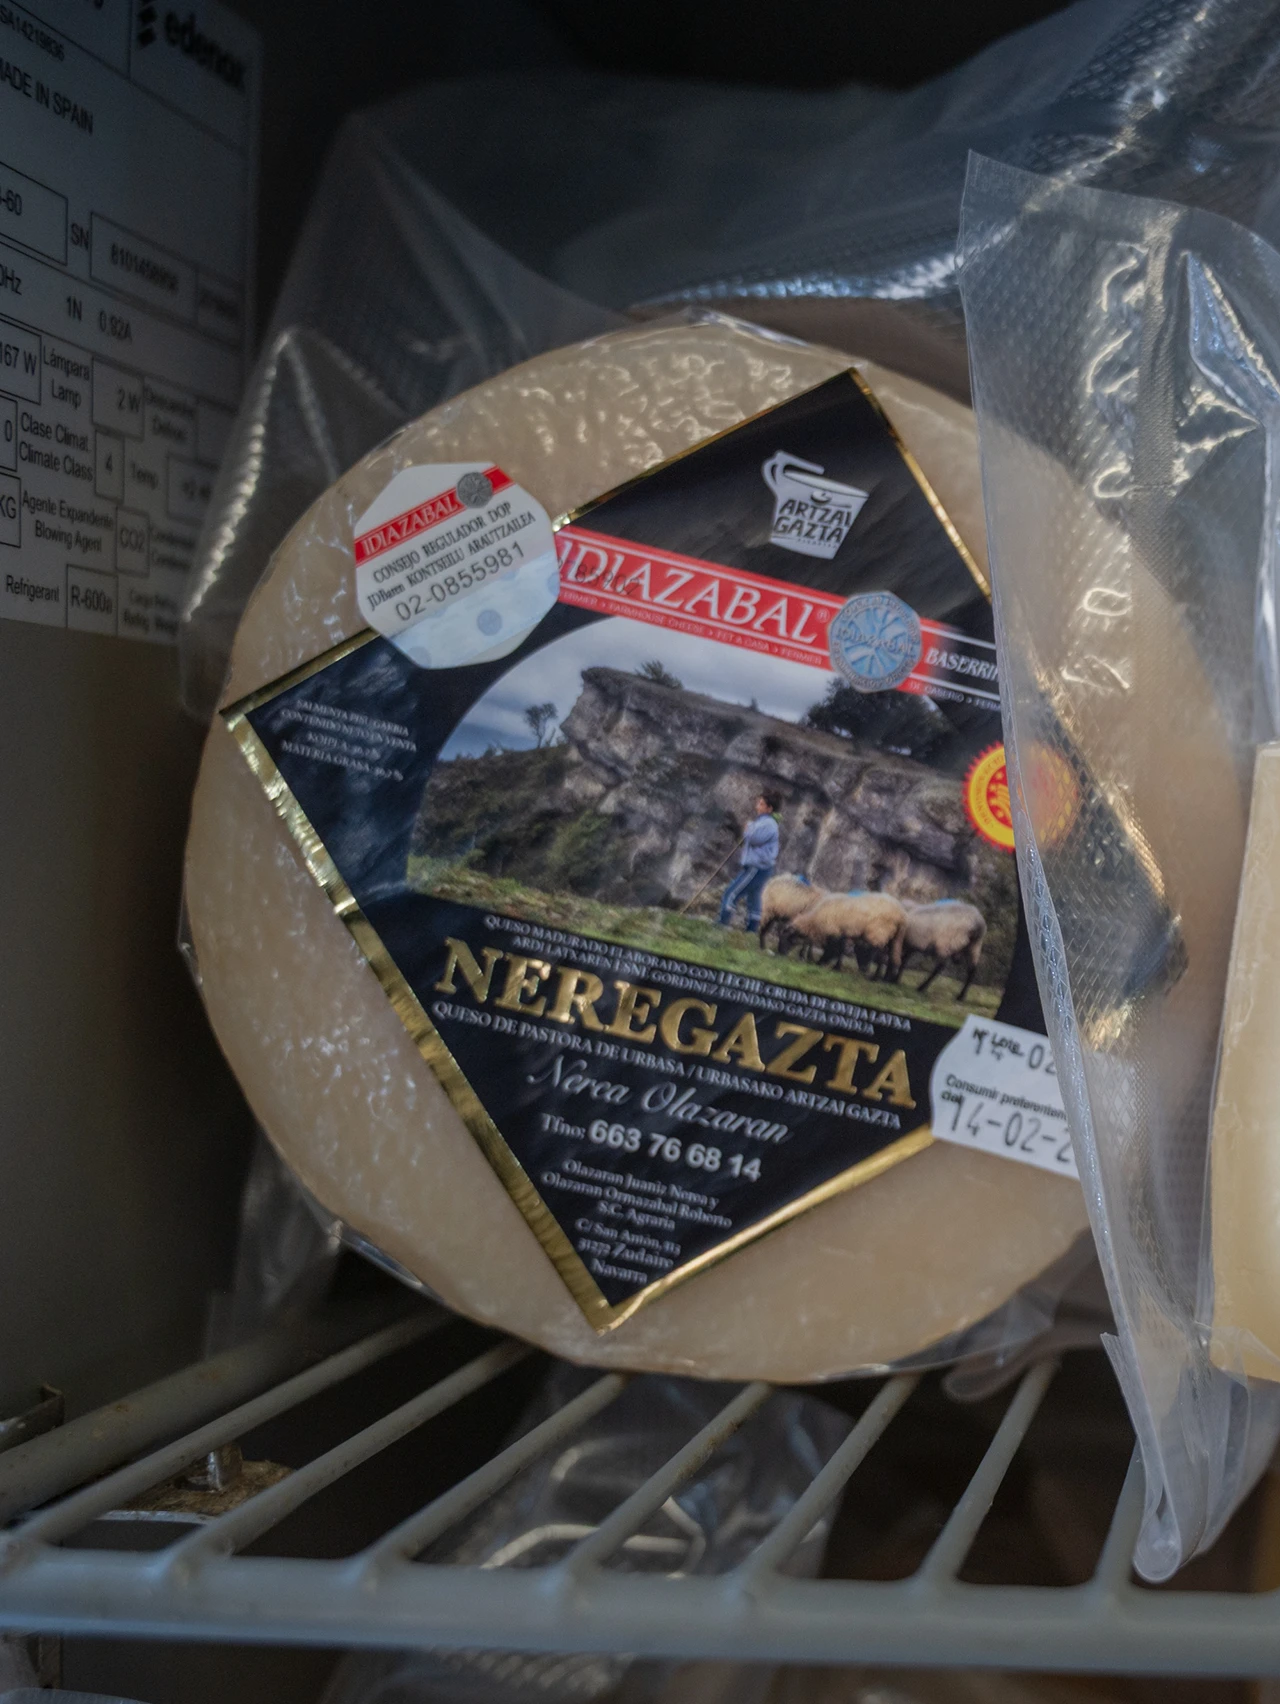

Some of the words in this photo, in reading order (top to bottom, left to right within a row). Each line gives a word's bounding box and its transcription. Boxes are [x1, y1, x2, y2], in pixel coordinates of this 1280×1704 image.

[36, 81, 50, 108] IN
[53, 92, 94, 134] SPAIN
[71, 223, 90, 250] SN
[51, 379, 81, 411] Lamp
[21, 412, 53, 440] Clase
[19, 441, 59, 472] Climate
[62, 455, 94, 484] Class
[21, 490, 57, 516] Agente
[359, 493, 460, 555] IDIAZABAL
[779, 494, 852, 530] ARTZAI
[35, 519, 73, 551] Blowing
[371, 549, 422, 585] CONSEJO
[421, 515, 488, 557] REGULADOR
[487, 500, 514, 522] DOP
[405, 547, 467, 587] KONTSEILU
[465, 510, 537, 555] ARAUTZAILEA
[773, 511, 843, 547] GAZTA
[6, 574, 60, 604] Refrigerant
[391, 540, 527, 622] 02-0855981
[432, 932, 929, 1114] NEREGAZTA
[430, 997, 492, 1030] QUESO
[491, 1013, 518, 1033] DE
[518, 1020, 595, 1053] PASTORA
[596, 1040, 623, 1060] DE
[622, 1046, 689, 1076] URBASA
[695, 1064, 784, 1100] URBASAKO
[785, 1086, 849, 1116] ARTZAI
[847, 1101, 904, 1130] GAZTA
[525, 1046, 634, 1108] Nerea
[639, 1075, 793, 1148] Olazaran
[586, 1116, 644, 1154] 663
[645, 1131, 684, 1164] 76
[683, 1140, 724, 1174] 68
[725, 1150, 764, 1183] 14
[589, 1258, 649, 1286] Navarra
